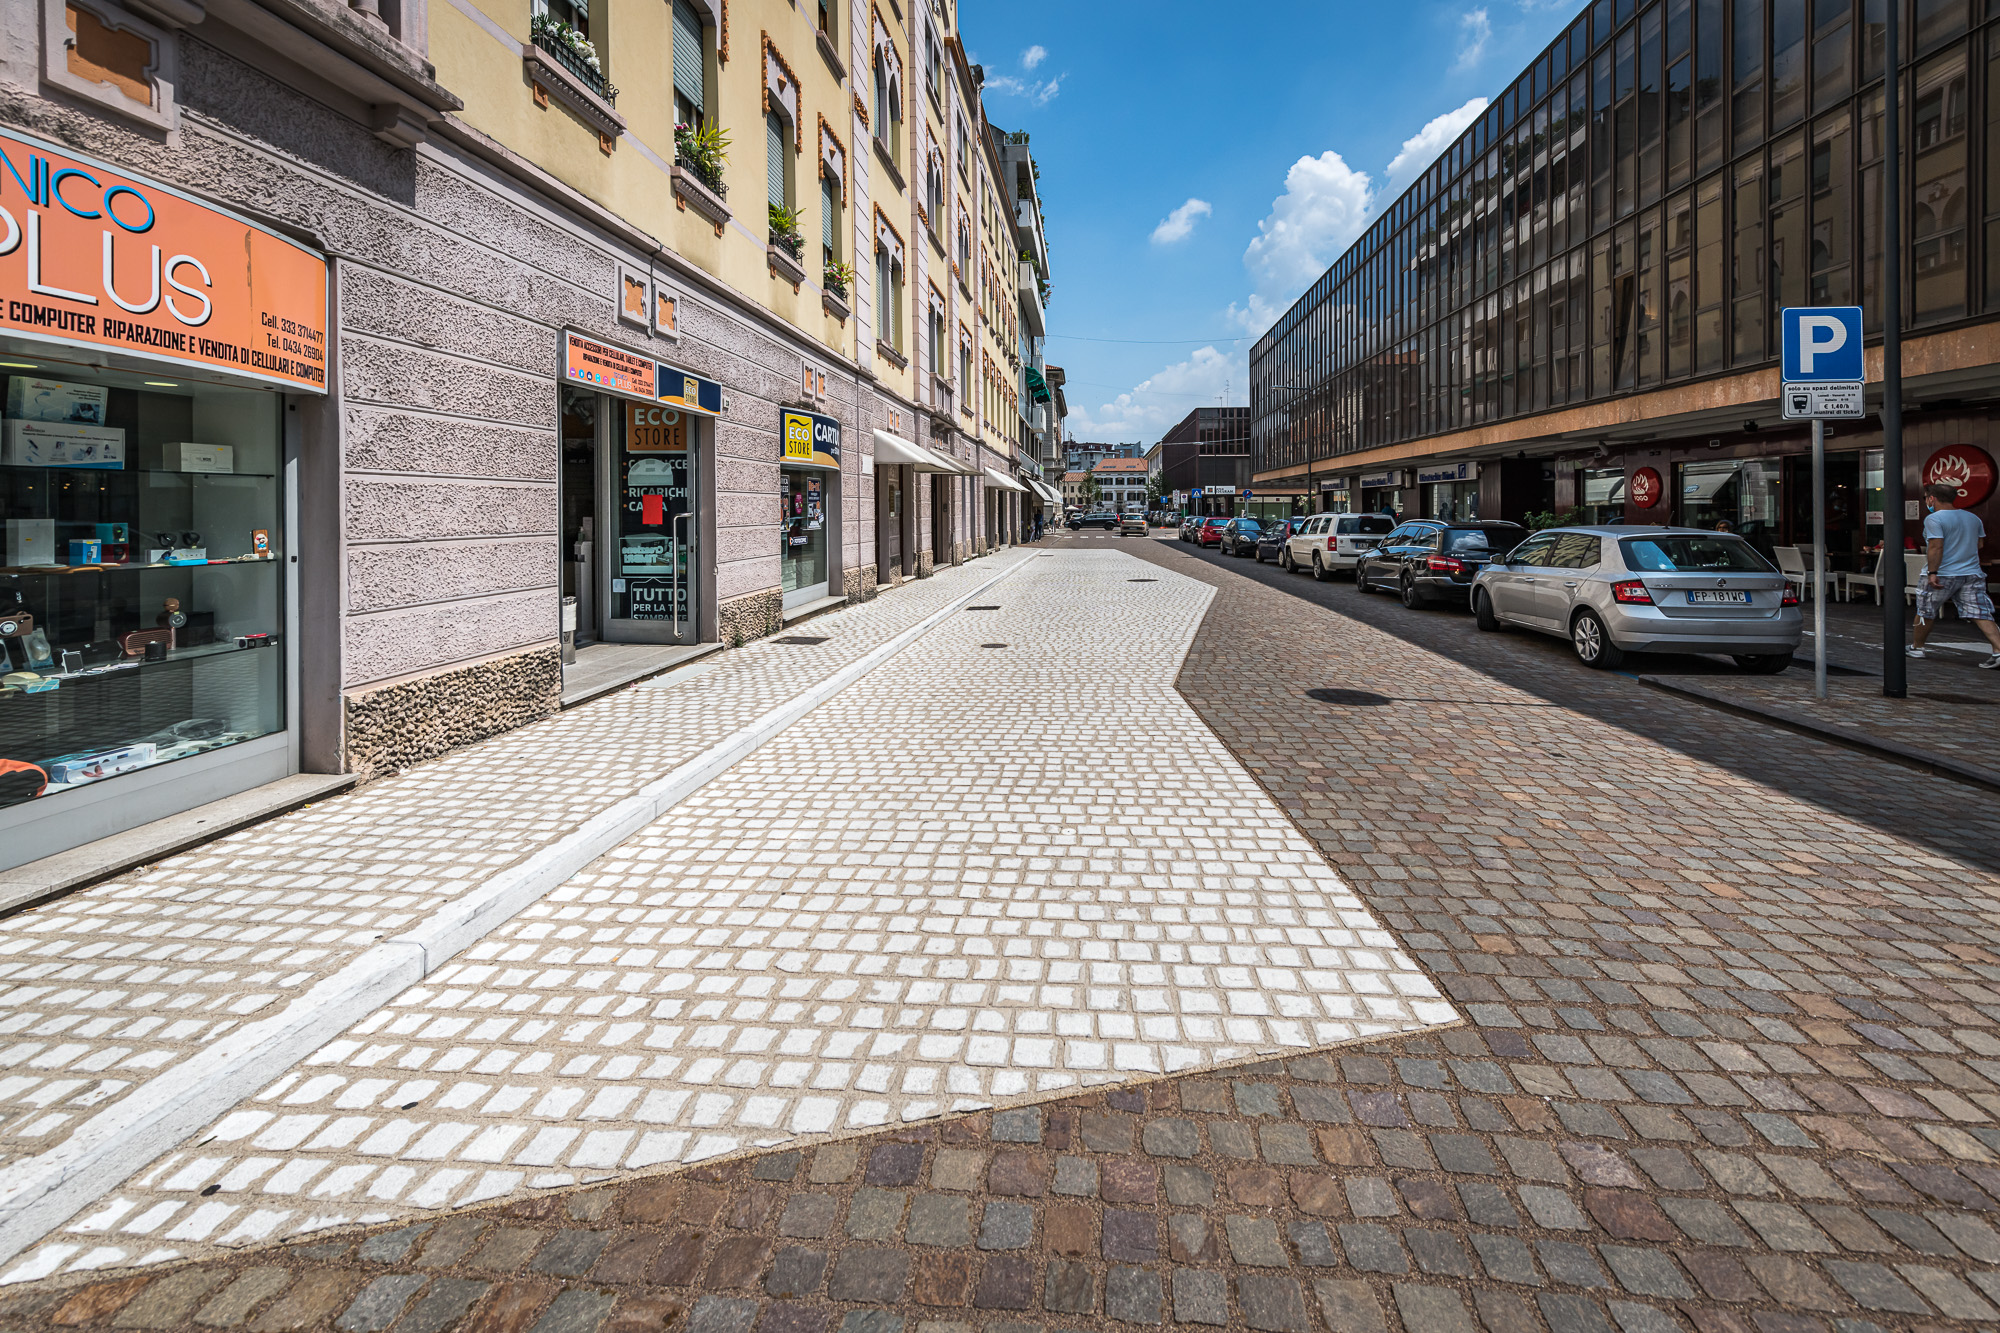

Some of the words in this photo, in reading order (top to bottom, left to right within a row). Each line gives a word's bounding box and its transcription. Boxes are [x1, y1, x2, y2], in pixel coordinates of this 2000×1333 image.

[261, 311, 279, 330] Cell.
[281, 317, 296, 335] 333
[9, 300, 96, 335] COMPUTER
[103, 317, 186, 352] RIPARAZIONE
[189, 336, 195, 354] E
[198, 337, 239, 363] VENDITA
[240, 348, 250, 365] DI
[251, 350, 289, 375] CELLULARI
[291, 360, 295, 375] E
[296, 361, 325, 383] COMPUTER
[266, 332, 281, 349] Tel.
[282, 337, 302, 355] 0434
[303, 344, 323, 362] 26904
[1799, 315, 1848, 374] P
[617, 379, 632, 390] PLUS
[685, 385, 697, 395] ECO
[685, 393, 697, 405] STORE
[634, 408, 680, 426] ECO
[634, 428, 680, 446] STORE
[788, 426, 810, 441] ECO
[788, 441, 810, 456] STORE
[633, 588, 687, 602] TUTTO
[633, 603, 652, 612] PER
[654, 603, 666, 612] LA
